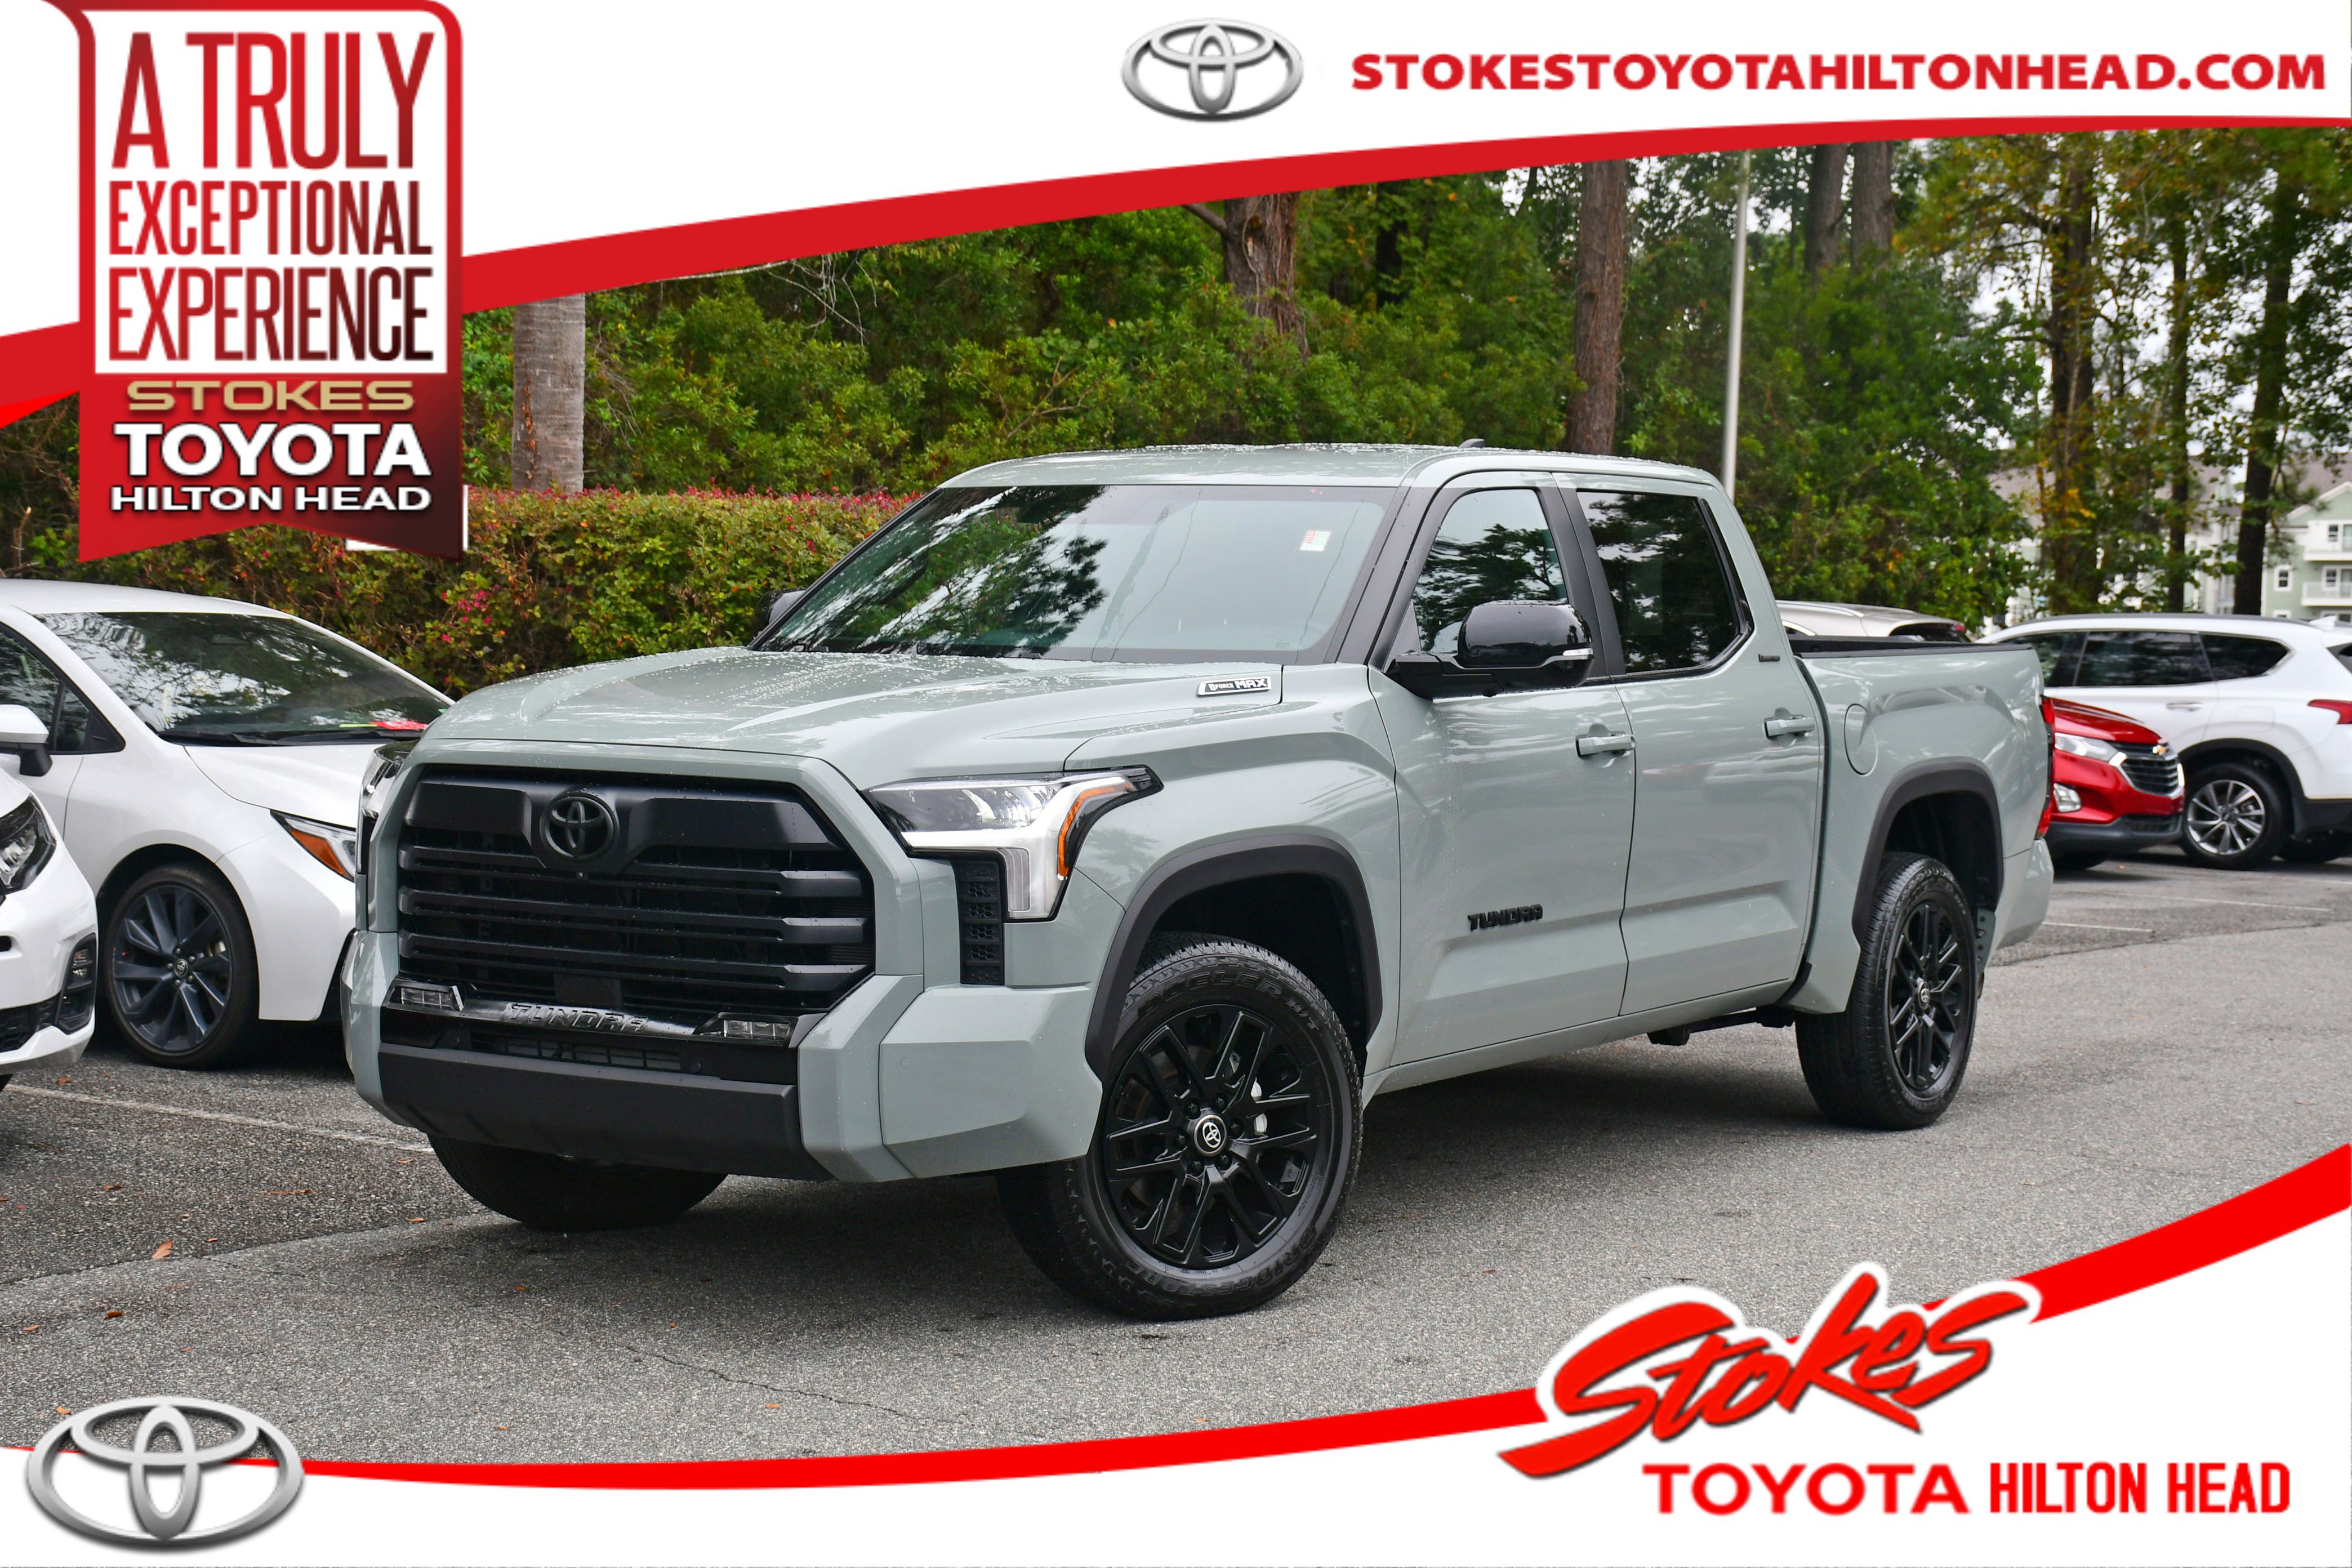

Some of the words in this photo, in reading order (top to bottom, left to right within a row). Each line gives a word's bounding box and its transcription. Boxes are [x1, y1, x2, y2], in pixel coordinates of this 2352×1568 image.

[1235, 678, 1267, 689] MAX
[1468, 903, 1543, 931] TUNDRA
[510, 1003, 648, 1032] TUNDRA
